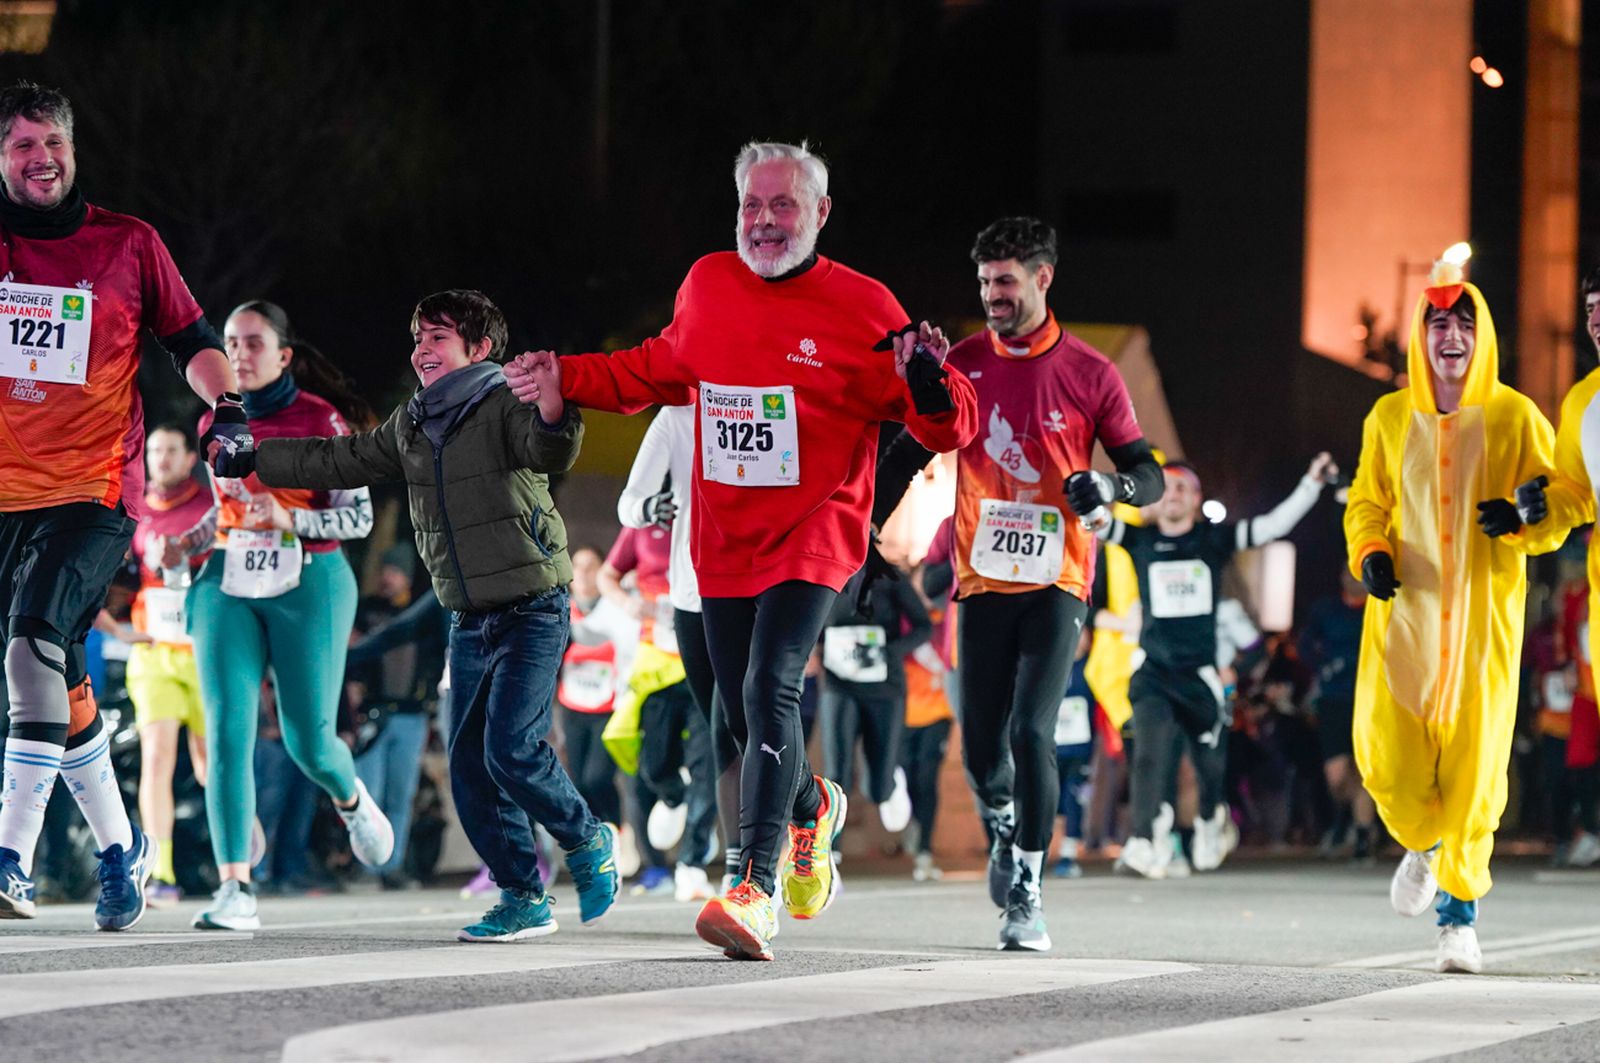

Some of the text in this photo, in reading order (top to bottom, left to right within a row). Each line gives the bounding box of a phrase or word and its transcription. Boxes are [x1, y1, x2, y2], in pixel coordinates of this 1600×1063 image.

[9, 294, 53, 307] NOCHE DE
[0, 304, 17, 315] SAN
[18, 305, 53, 319] ANTÓN
[9, 318, 66, 350] 1221
[22, 348, 47, 357] CARLOS
[15, 378, 37, 389] SAN
[11, 387, 47, 401] ANTÓN
[713, 395, 753, 407] NOCHE DE
[707, 406, 723, 418] SAN
[723, 407, 754, 421] ANTÓN
[716, 420, 774, 452] 3125
[738, 453, 760, 462] Carlos
[1000, 447, 1022, 471] 43
[997, 510, 1033, 521] NOCHE DE
[986, 519, 1002, 527] SAN
[991, 529, 1047, 557] 2037
[245, 549, 279, 572] 824
